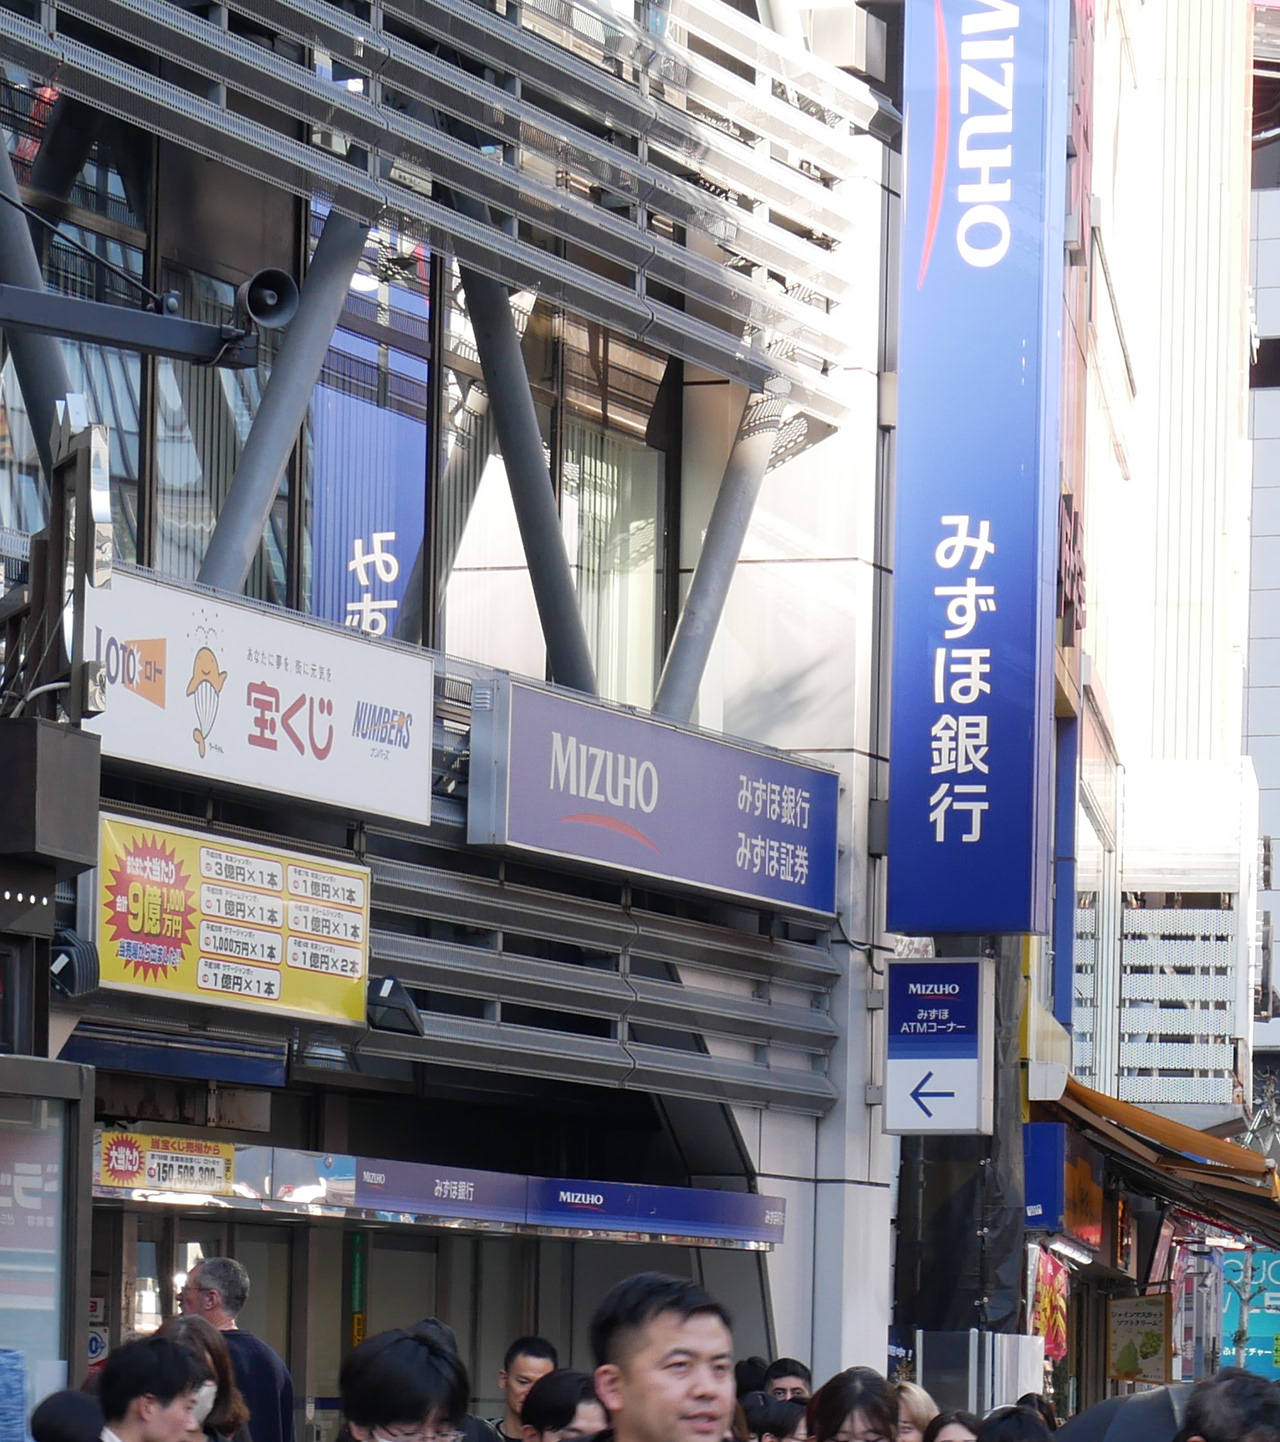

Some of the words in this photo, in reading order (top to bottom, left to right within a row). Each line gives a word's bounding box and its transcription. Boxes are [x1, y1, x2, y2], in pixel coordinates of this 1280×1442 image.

[929, 515, 997, 843] みずほ銀行
[247, 680, 333, 761] 宝くじ
[352, 699, 413, 750] NUMBERS
[549, 731, 659, 814] MIZUHO
[737, 775, 810, 829] みずほ銀行
[736, 832, 809, 885] みずほ証券
[909, 984, 960, 995] MIZUHO
[917, 1009, 950, 1021] みずほ
[900, 1022, 966, 1033] ATMコーナー
[151, 1138, 221, 1155] 当宝くじ売場から
[109, 1146, 140, 1172] 大当たり
[363, 1171, 386, 1185] MIZUHO
[434, 1179, 475, 1202] みずほ銀行
[559, 1191, 604, 1206] MIZUHO
